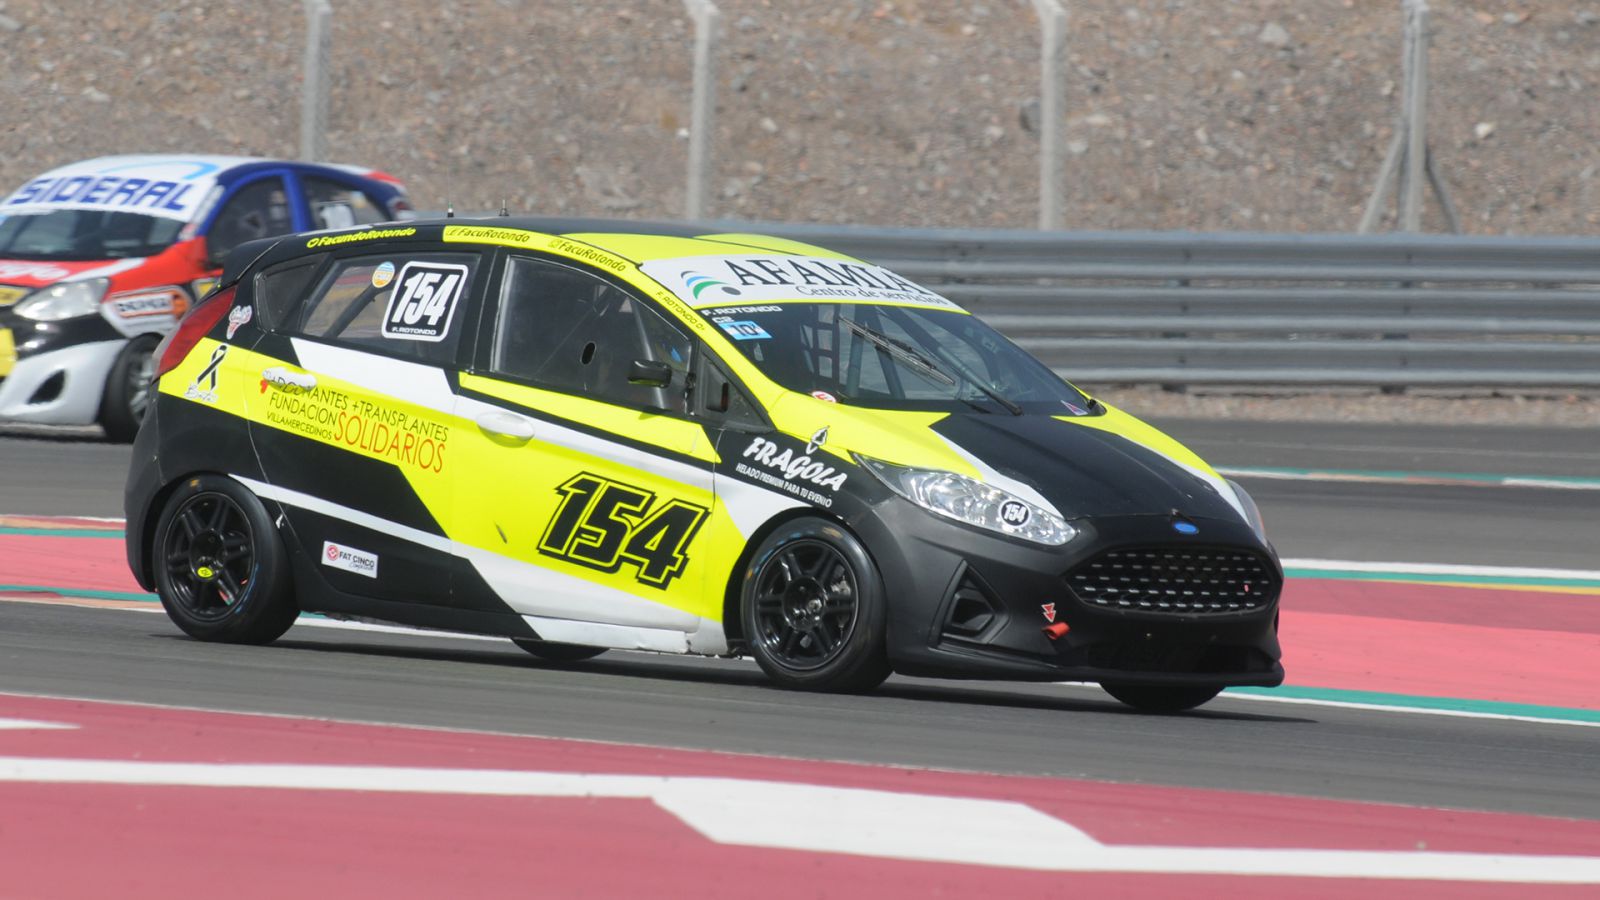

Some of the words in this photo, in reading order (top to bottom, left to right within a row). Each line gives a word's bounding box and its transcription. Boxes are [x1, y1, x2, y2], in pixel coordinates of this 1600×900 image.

[11, 175, 193, 211] SIDERAL
[318, 227, 416, 247] FacundoRotondo
[458, 227, 530, 243] FacuRotondo
[558, 241, 626, 272] FacuRotondo
[724, 259, 933, 296] AFAMIA
[795, 284, 857, 297] Centro
[858, 287, 879, 298] de
[391, 271, 460, 325] 154
[663, 296, 698, 325] ROTONDO
[269, 391, 338, 426] FUNDACION
[266, 411, 332, 440] VILLAMERCEDINOS
[334, 411, 446, 474] SOLIDARIOS
[735, 462, 761, 480] HELADO
[783, 481, 801, 495] PARA
[800, 487, 809, 498] TU
[742, 436, 848, 491] FRAGOLA
[1003, 503, 1027, 523] 154
[535, 471, 713, 591] 154
[339, 551, 352, 561] FAT
[352, 555, 375, 568] CINCO
